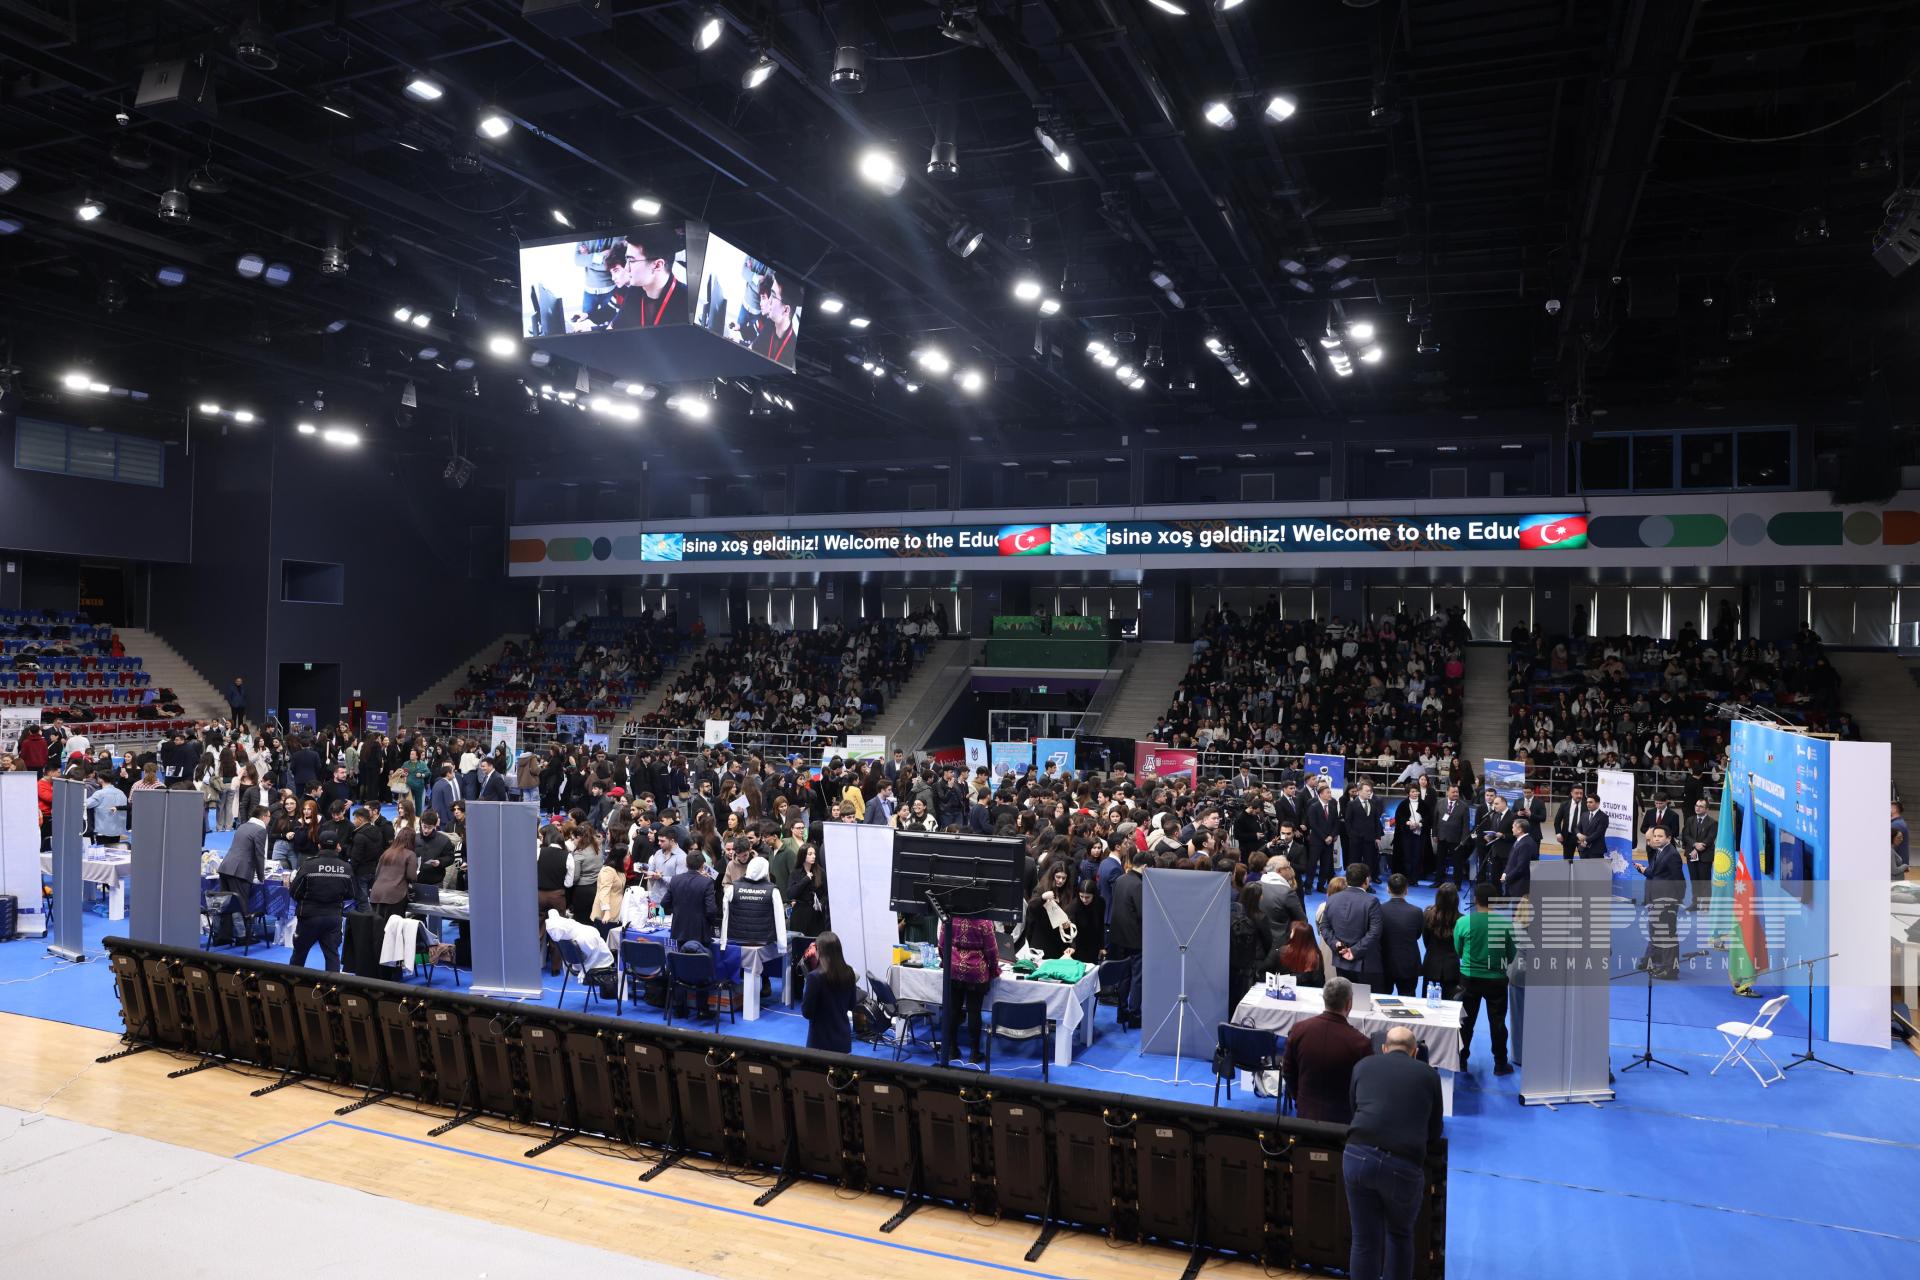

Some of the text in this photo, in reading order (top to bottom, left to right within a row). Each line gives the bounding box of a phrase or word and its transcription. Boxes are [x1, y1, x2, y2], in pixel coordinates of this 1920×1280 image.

[721, 540, 748, 556] xoş
[752, 536, 819, 555] gəldiniz!
[824, 534, 899, 550] Welcome
[904, 534, 922, 549] to
[926, 533, 953, 549] the
[1106, 528, 1152, 545] isinə
[1158, 531, 1194, 549] xoş
[1199, 525, 1286, 548] gəldiniz!
[1292, 525, 1391, 542] Welcome
[1397, 524, 1420, 541] to
[1425, 523, 1461, 540] the
[1602, 802, 1621, 810] STUDY
